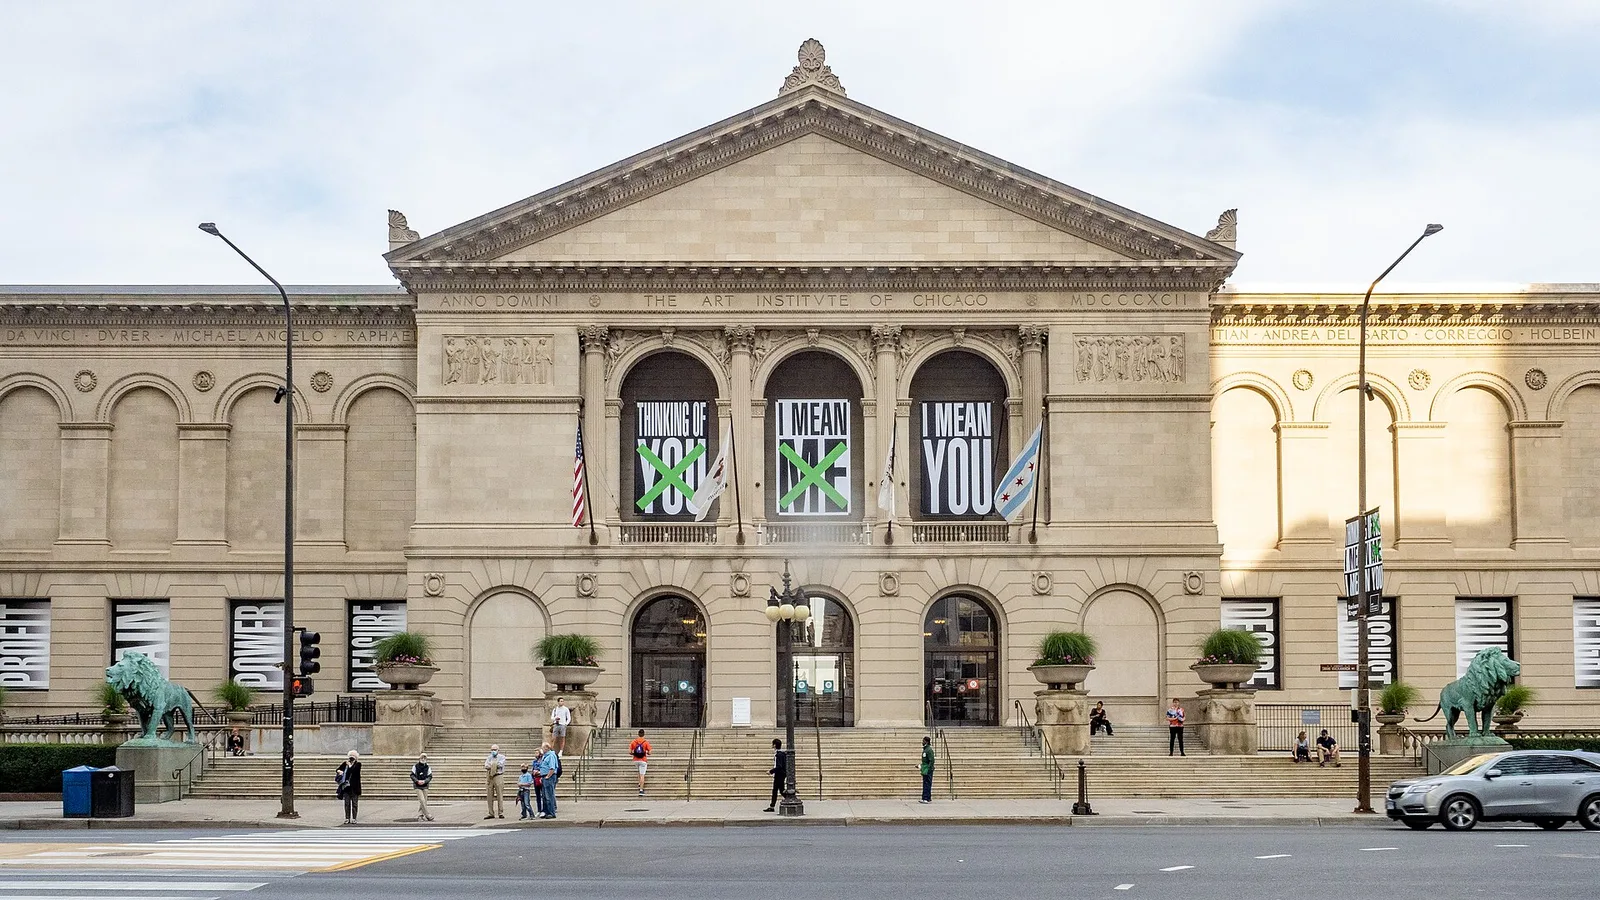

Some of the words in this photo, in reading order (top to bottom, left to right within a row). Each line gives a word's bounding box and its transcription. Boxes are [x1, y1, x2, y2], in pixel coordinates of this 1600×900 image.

[440, 295, 487, 307] ANNO
[495, 295, 558, 307] DOMINI
[644, 295, 677, 307] THE
[702, 295, 735, 307] ART
[756, 295, 849, 307] INSTITVTE
[870, 294, 893, 307] OF
[913, 294, 988, 307] CHICAGO
[1070, 294, 1187, 306] MDCCCXCII
[6, 330, 26, 341] DA
[33, 330, 76, 341] VINCI
[98, 330, 150, 341] DVRER
[173, 330, 247, 342] MICHAEL
[254, 330, 324, 342] ANGELO
[1209, 329, 1249, 341] ITIAN
[1262, 329, 1319, 341] ANDREA
[1327, 329, 1355, 341] DEL
[1364, 329, 1409, 341] SARTO
[1424, 329, 1513, 341] CORREGGIO
[1530, 329, 1596, 341] HOLBEIN
[637, 402, 689, 437] THINKING
[693, 402, 707, 437] OF
[779, 403, 784, 435] I
[792, 403, 847, 435] MEAN
[922, 403, 928, 437] I
[935, 403, 991, 437] MEAN
[637, 437, 707, 515] YOU
[779, 439, 848, 512] ME
[923, 438, 992, 515] YOU
[0, 604, 50, 687] PROFIT
[115, 605, 170, 667] AIN
[232, 605, 284, 688] POWER
